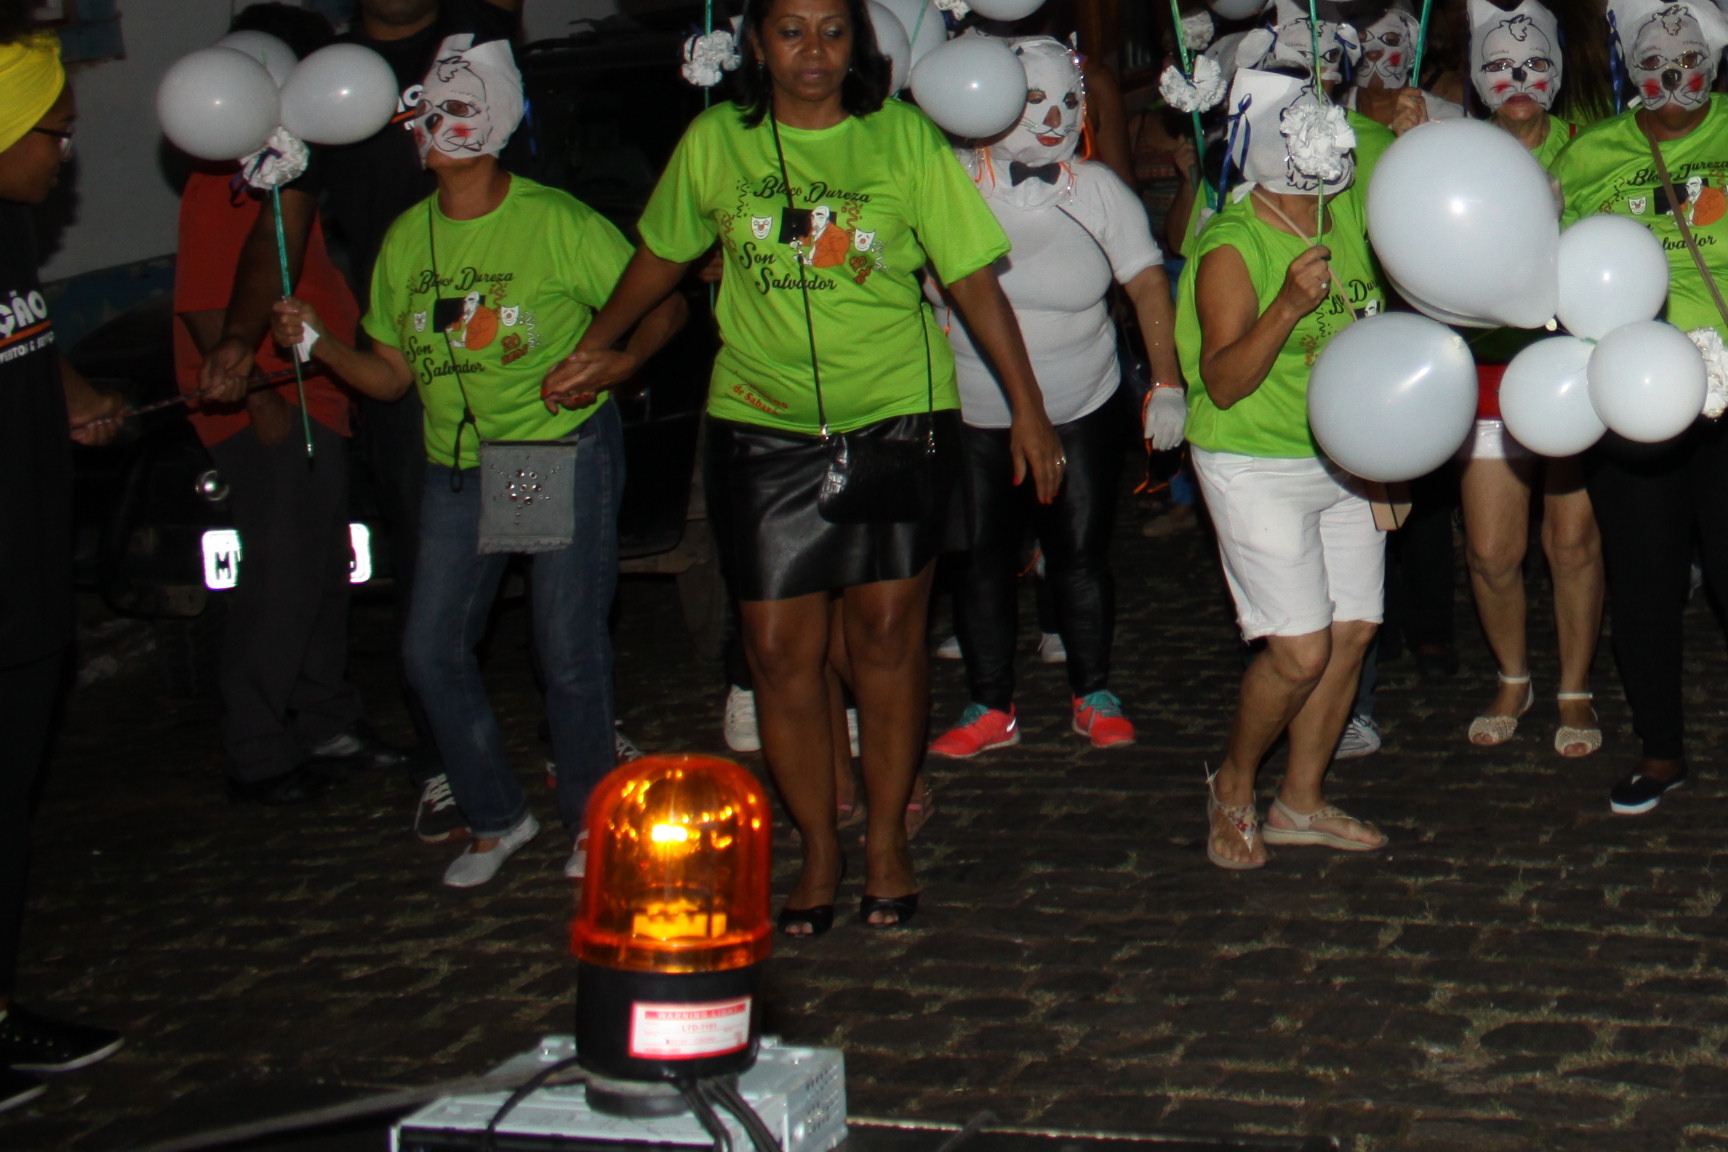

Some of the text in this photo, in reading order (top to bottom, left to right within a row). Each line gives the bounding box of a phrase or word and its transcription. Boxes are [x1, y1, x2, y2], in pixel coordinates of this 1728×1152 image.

[804, 181, 872, 204] Dureza
[739, 241, 777, 269] Son
[455, 266, 514, 291] Dureza
[754, 267, 838, 296] Salvador
[406, 335, 434, 363] Son
[420, 357, 485, 385] Salvador
